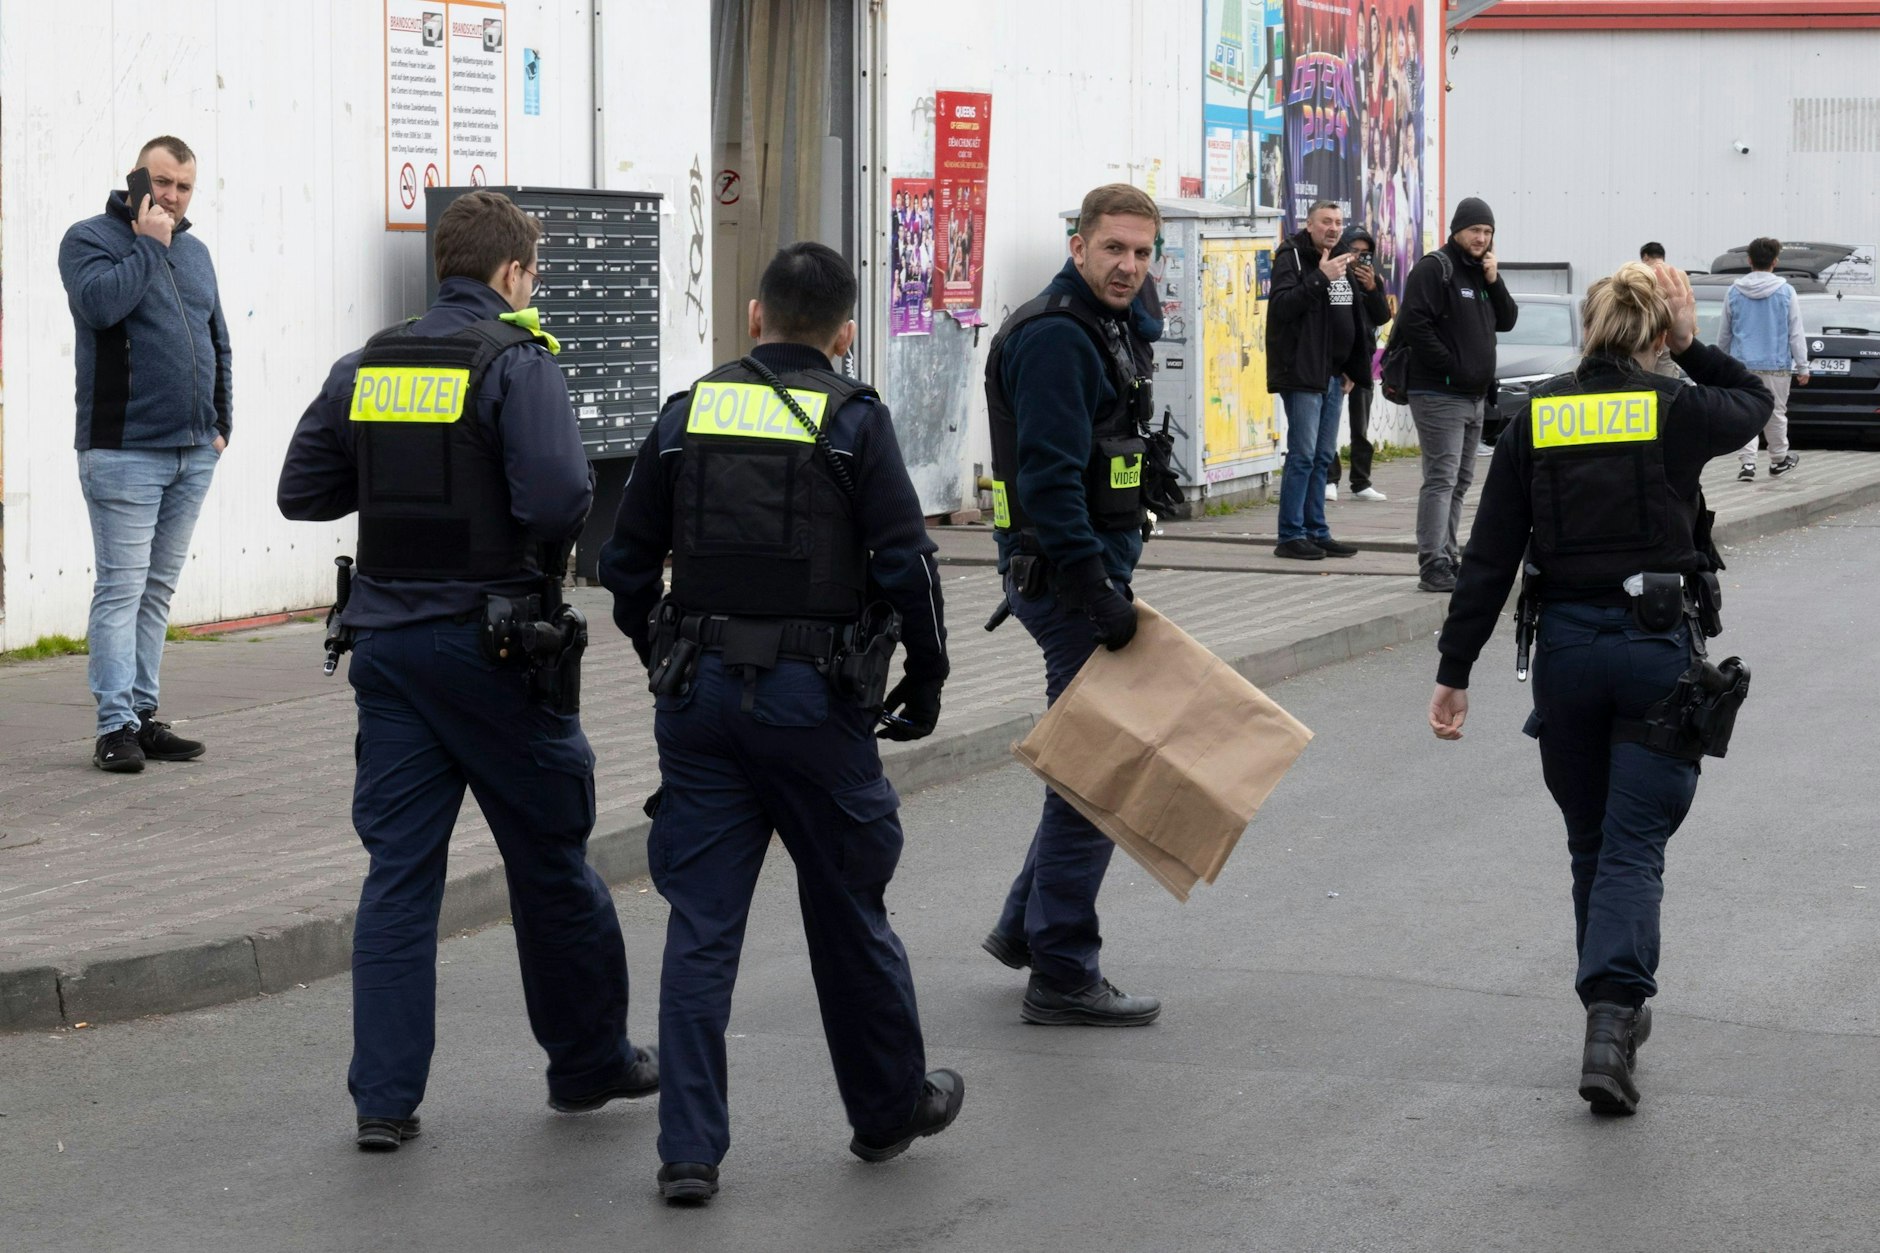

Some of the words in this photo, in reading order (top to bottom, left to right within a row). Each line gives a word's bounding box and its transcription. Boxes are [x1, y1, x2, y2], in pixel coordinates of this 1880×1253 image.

[390, 16, 422, 30] BRANDSCHUTZ
[452, 22, 482, 35] BRANDSCHUTZ
[1303, 105, 1350, 159] 2024
[1820, 360, 1845, 370] 9435
[358, 376, 460, 414] POLIZEI
[692, 388, 822, 437] POLIZEI
[1538, 400, 1650, 440] POLIZEI
[1114, 471, 1138, 484] VIDEO
